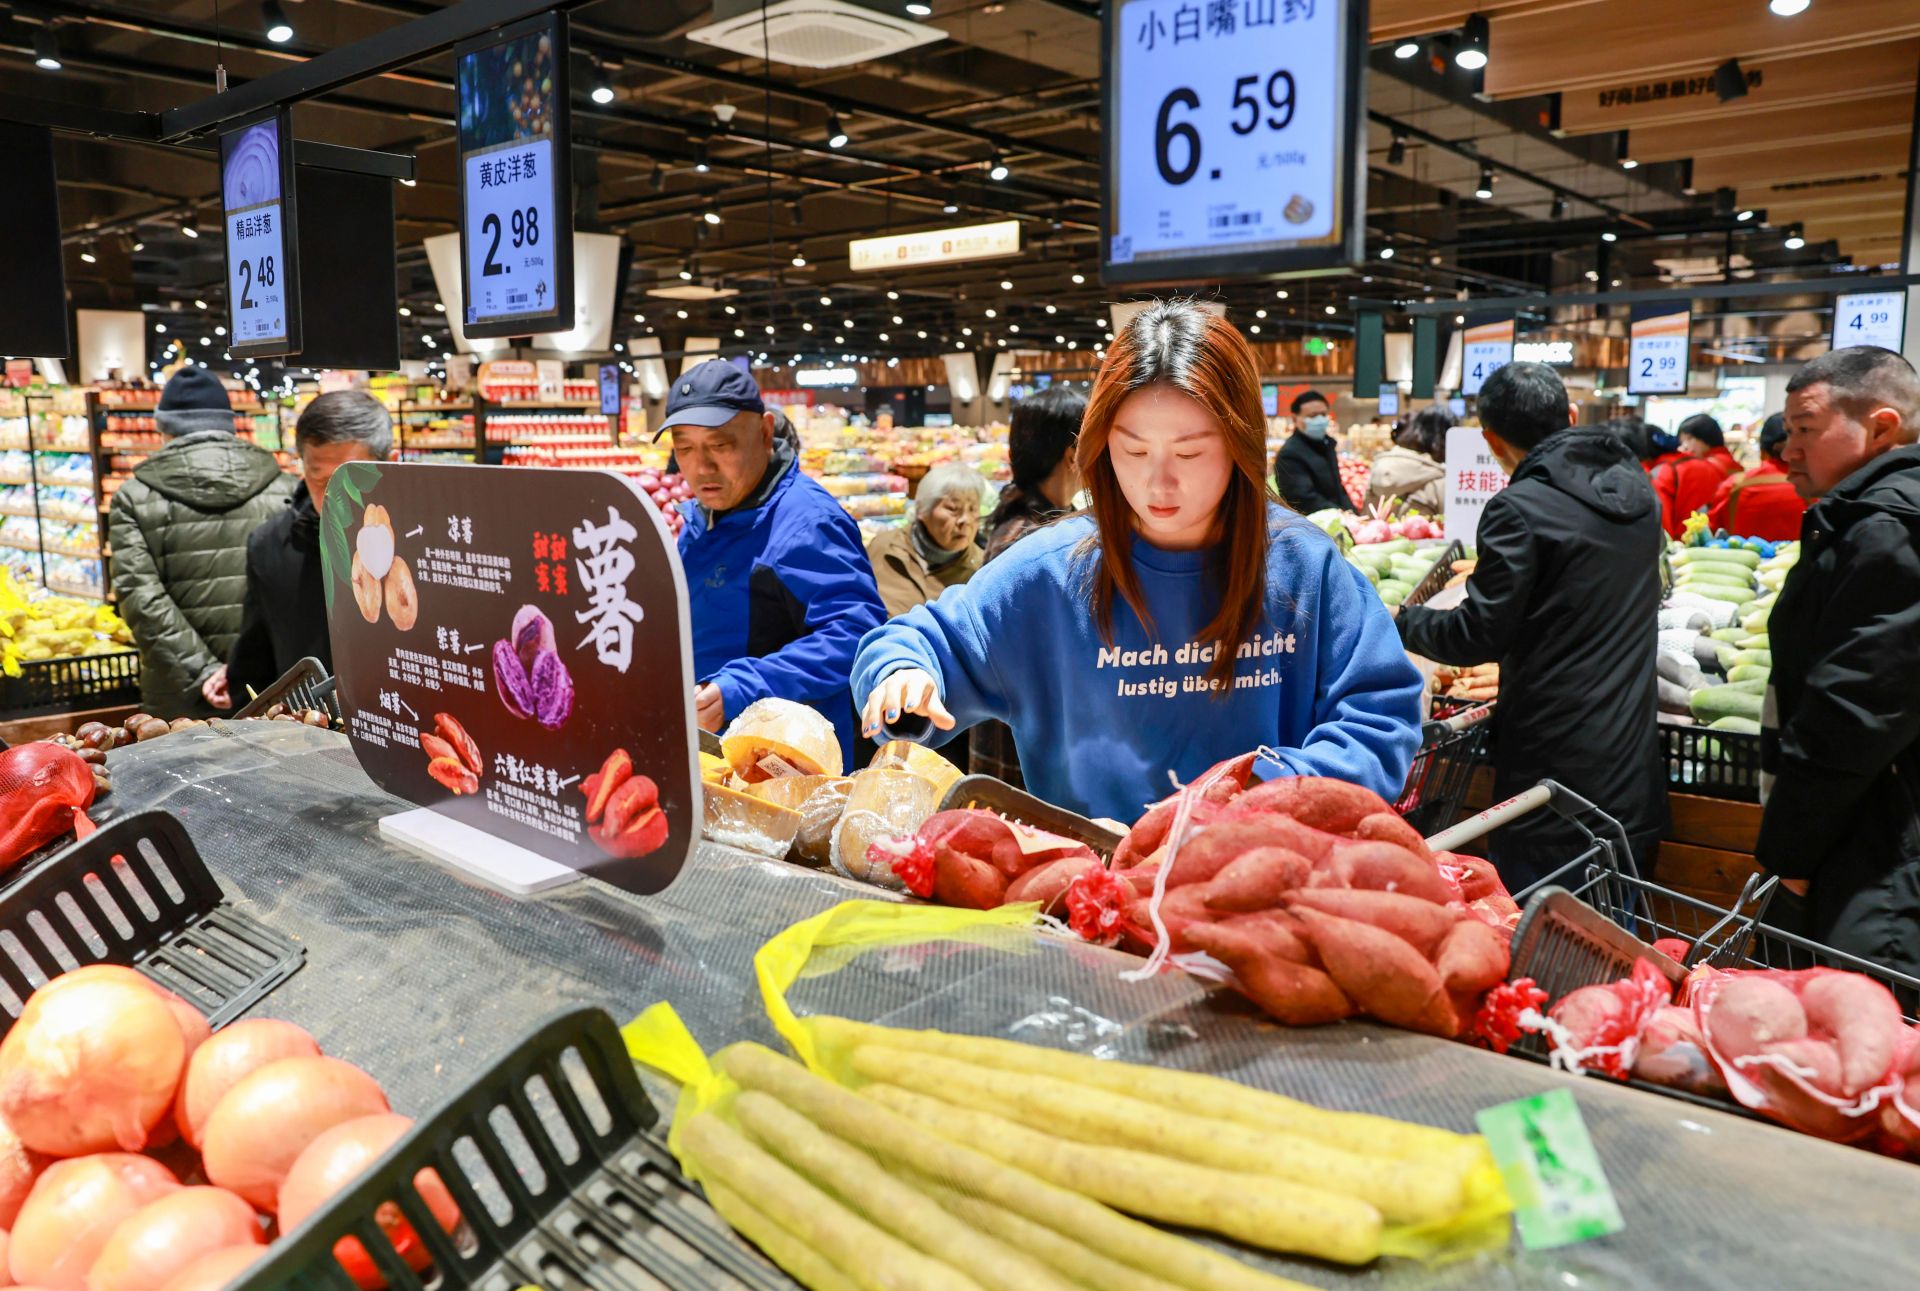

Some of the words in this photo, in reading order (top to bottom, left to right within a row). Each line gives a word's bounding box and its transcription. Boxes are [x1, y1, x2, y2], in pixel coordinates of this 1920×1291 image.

[1138, 0, 1315, 51] 小白嘴山药
[1155, 69, 1296, 186] 6.59
[480, 152, 537, 189] 黄皮洋葱
[236, 213, 272, 240] 精品洋葱
[482, 206, 540, 276] 2.98
[239, 255, 275, 309] 2.48
[1850, 312, 1888, 330] 4.99
[1641, 356, 1676, 377] 2.99
[448, 515, 473, 544] 凉薯
[572, 505, 644, 674] 薯
[437, 625, 460, 655] 紫薯
[1096, 644, 1169, 668] Mach
[1236, 633, 1296, 659] nicht
[1117, 676, 1178, 698] lustig
[1235, 667, 1283, 688] mich.
[379, 688, 400, 715] 烟薯
